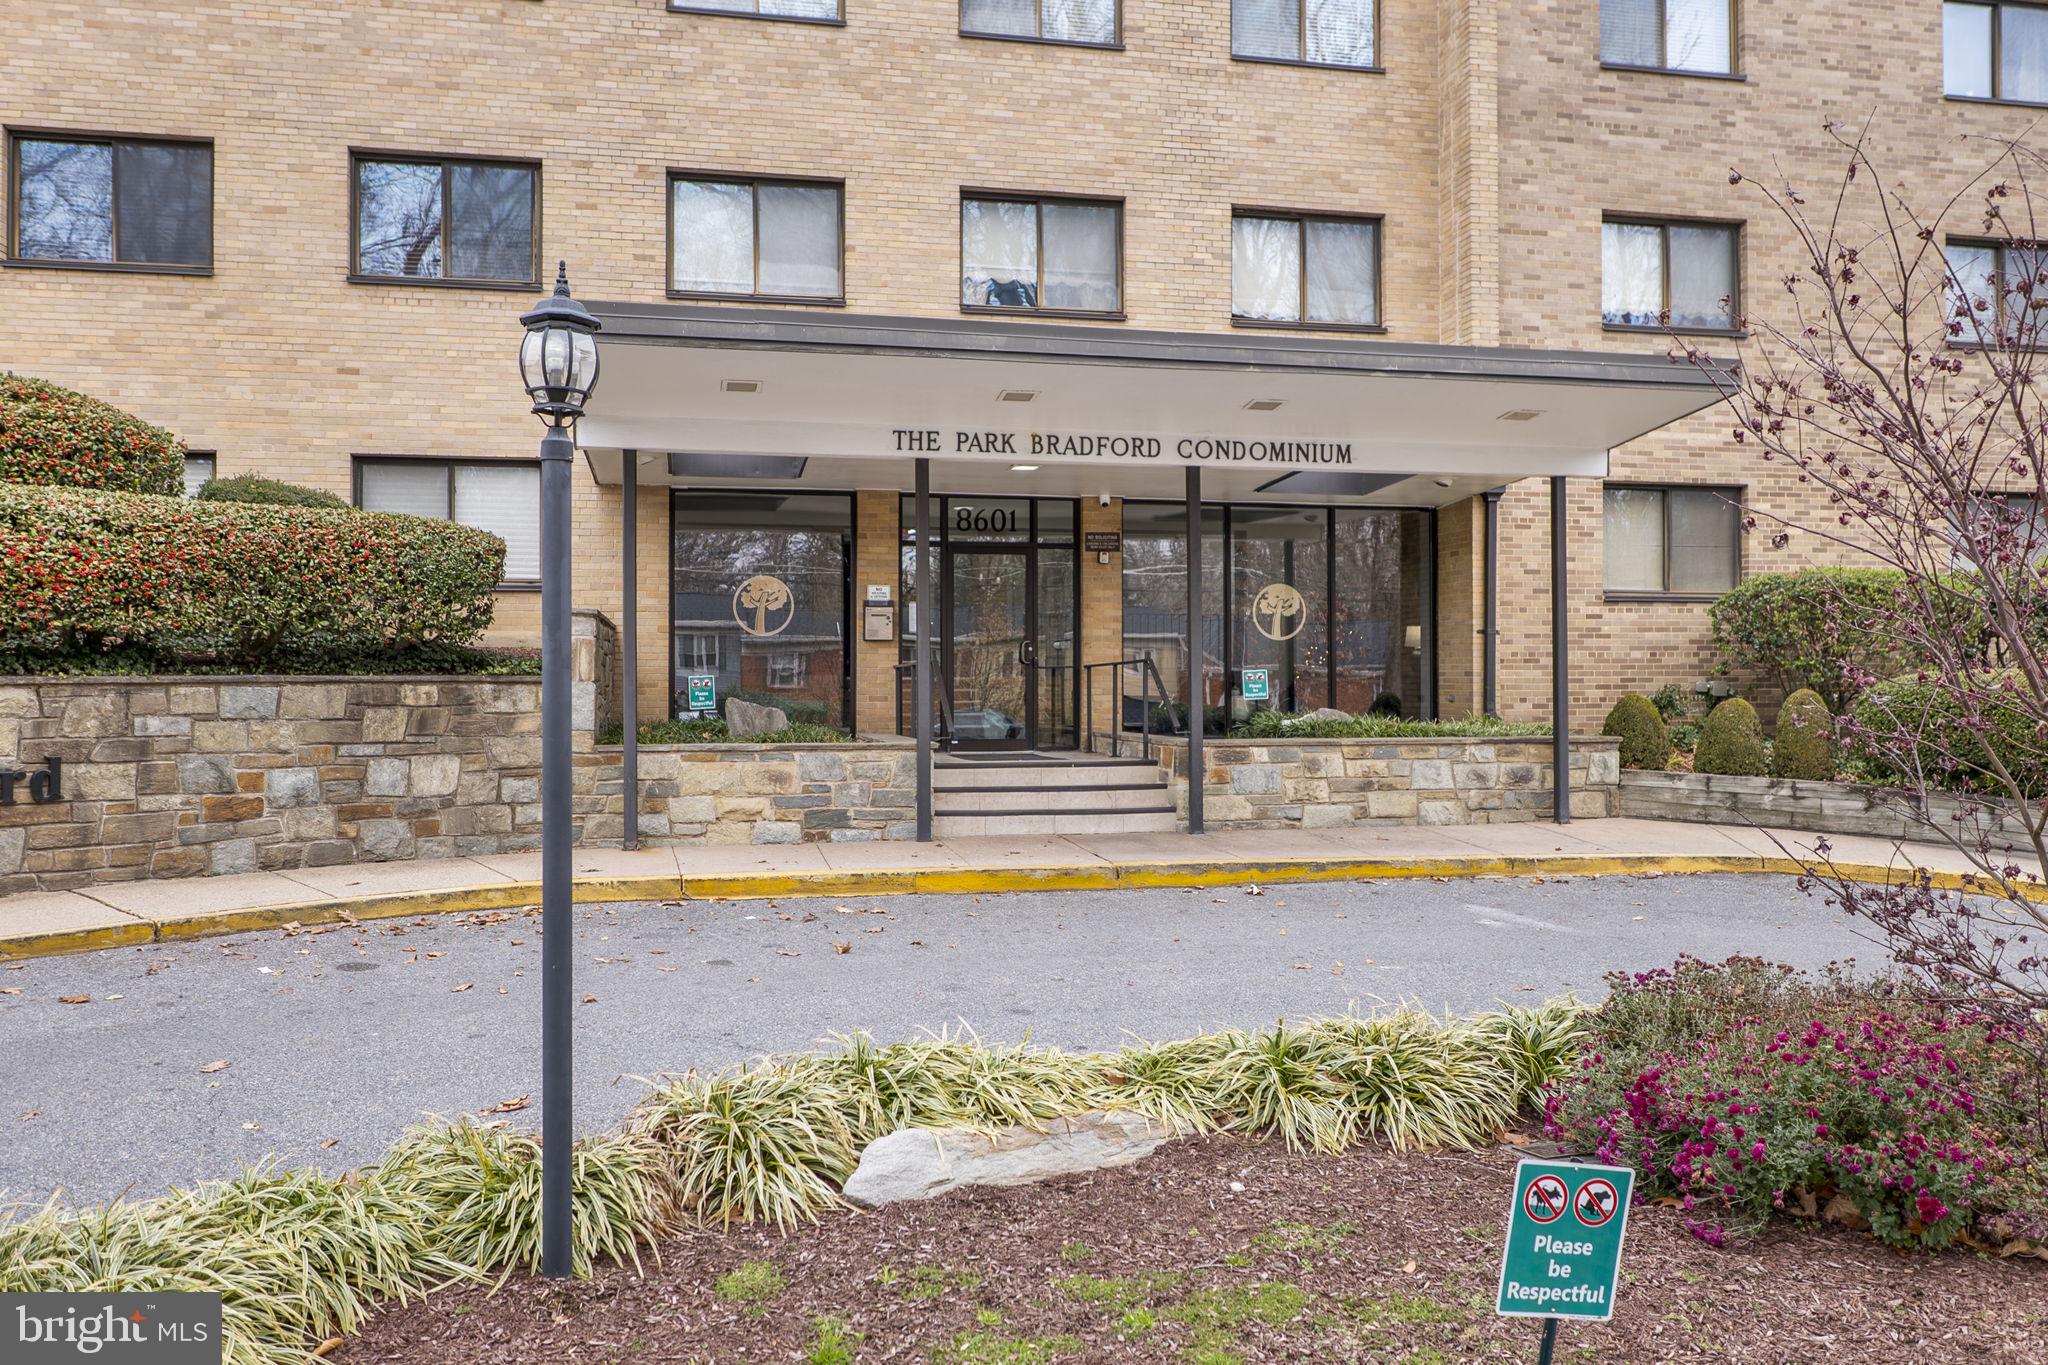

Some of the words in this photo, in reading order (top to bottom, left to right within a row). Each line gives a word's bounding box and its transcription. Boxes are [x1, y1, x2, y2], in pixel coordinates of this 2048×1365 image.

[892, 430, 941, 452] THE
[955, 431, 1017, 454] PARK
[1030, 433, 1161, 458] BRADFORD
[1177, 439, 1353, 464] CONDOMINIUM
[956, 508, 1017, 533] 8601
[1533, 1234, 1594, 1256] Please
[1547, 1258, 1572, 1278] be
[1506, 1280, 1605, 1305] Respectful
